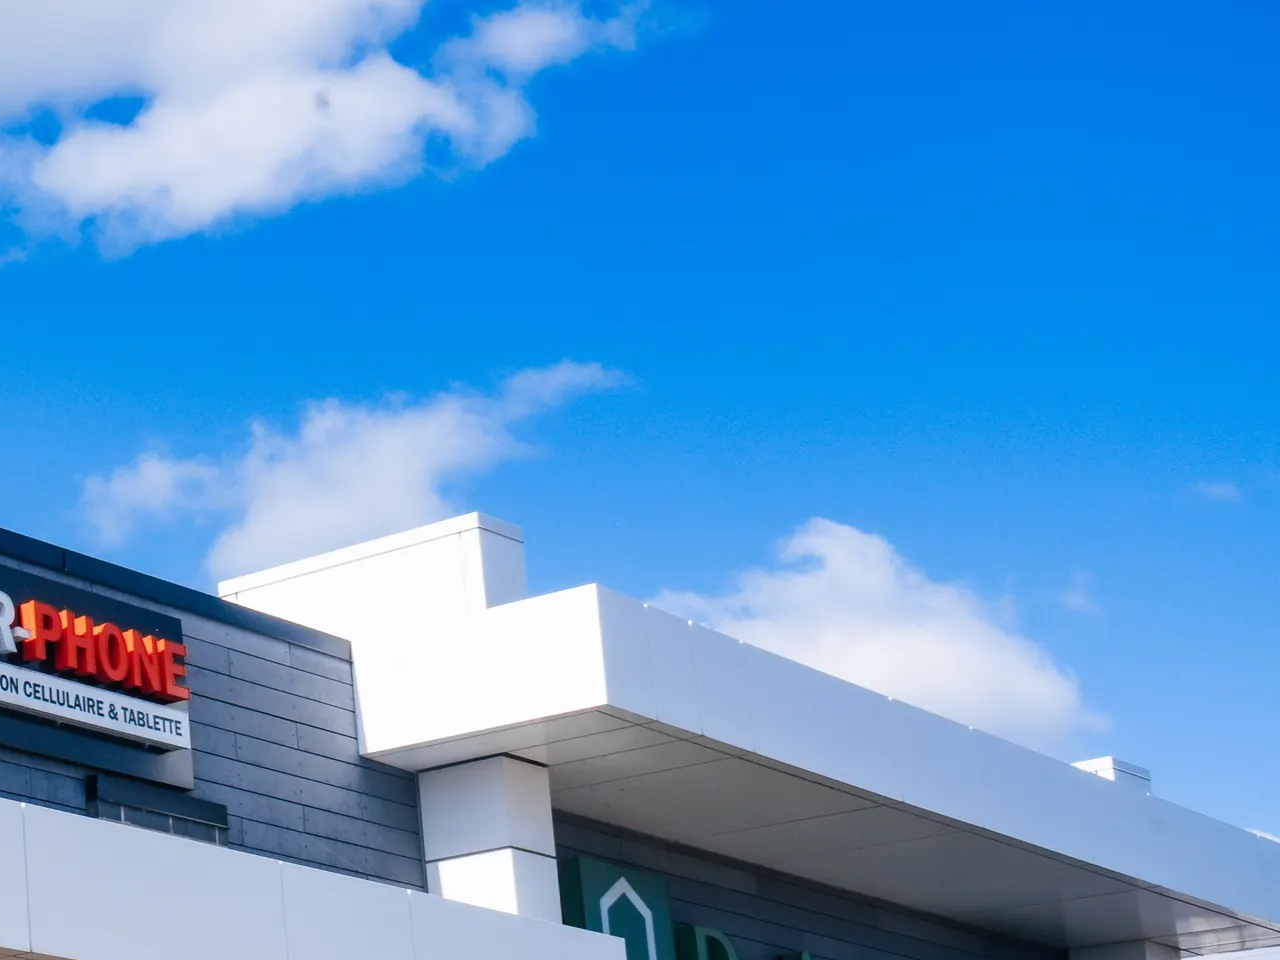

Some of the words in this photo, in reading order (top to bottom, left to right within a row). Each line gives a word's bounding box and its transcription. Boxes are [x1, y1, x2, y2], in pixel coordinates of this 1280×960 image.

[23, 681, 104, 718] CELLULAIRE
[108, 703, 119, 721] &
[121, 706, 183, 737] TABLETTE
